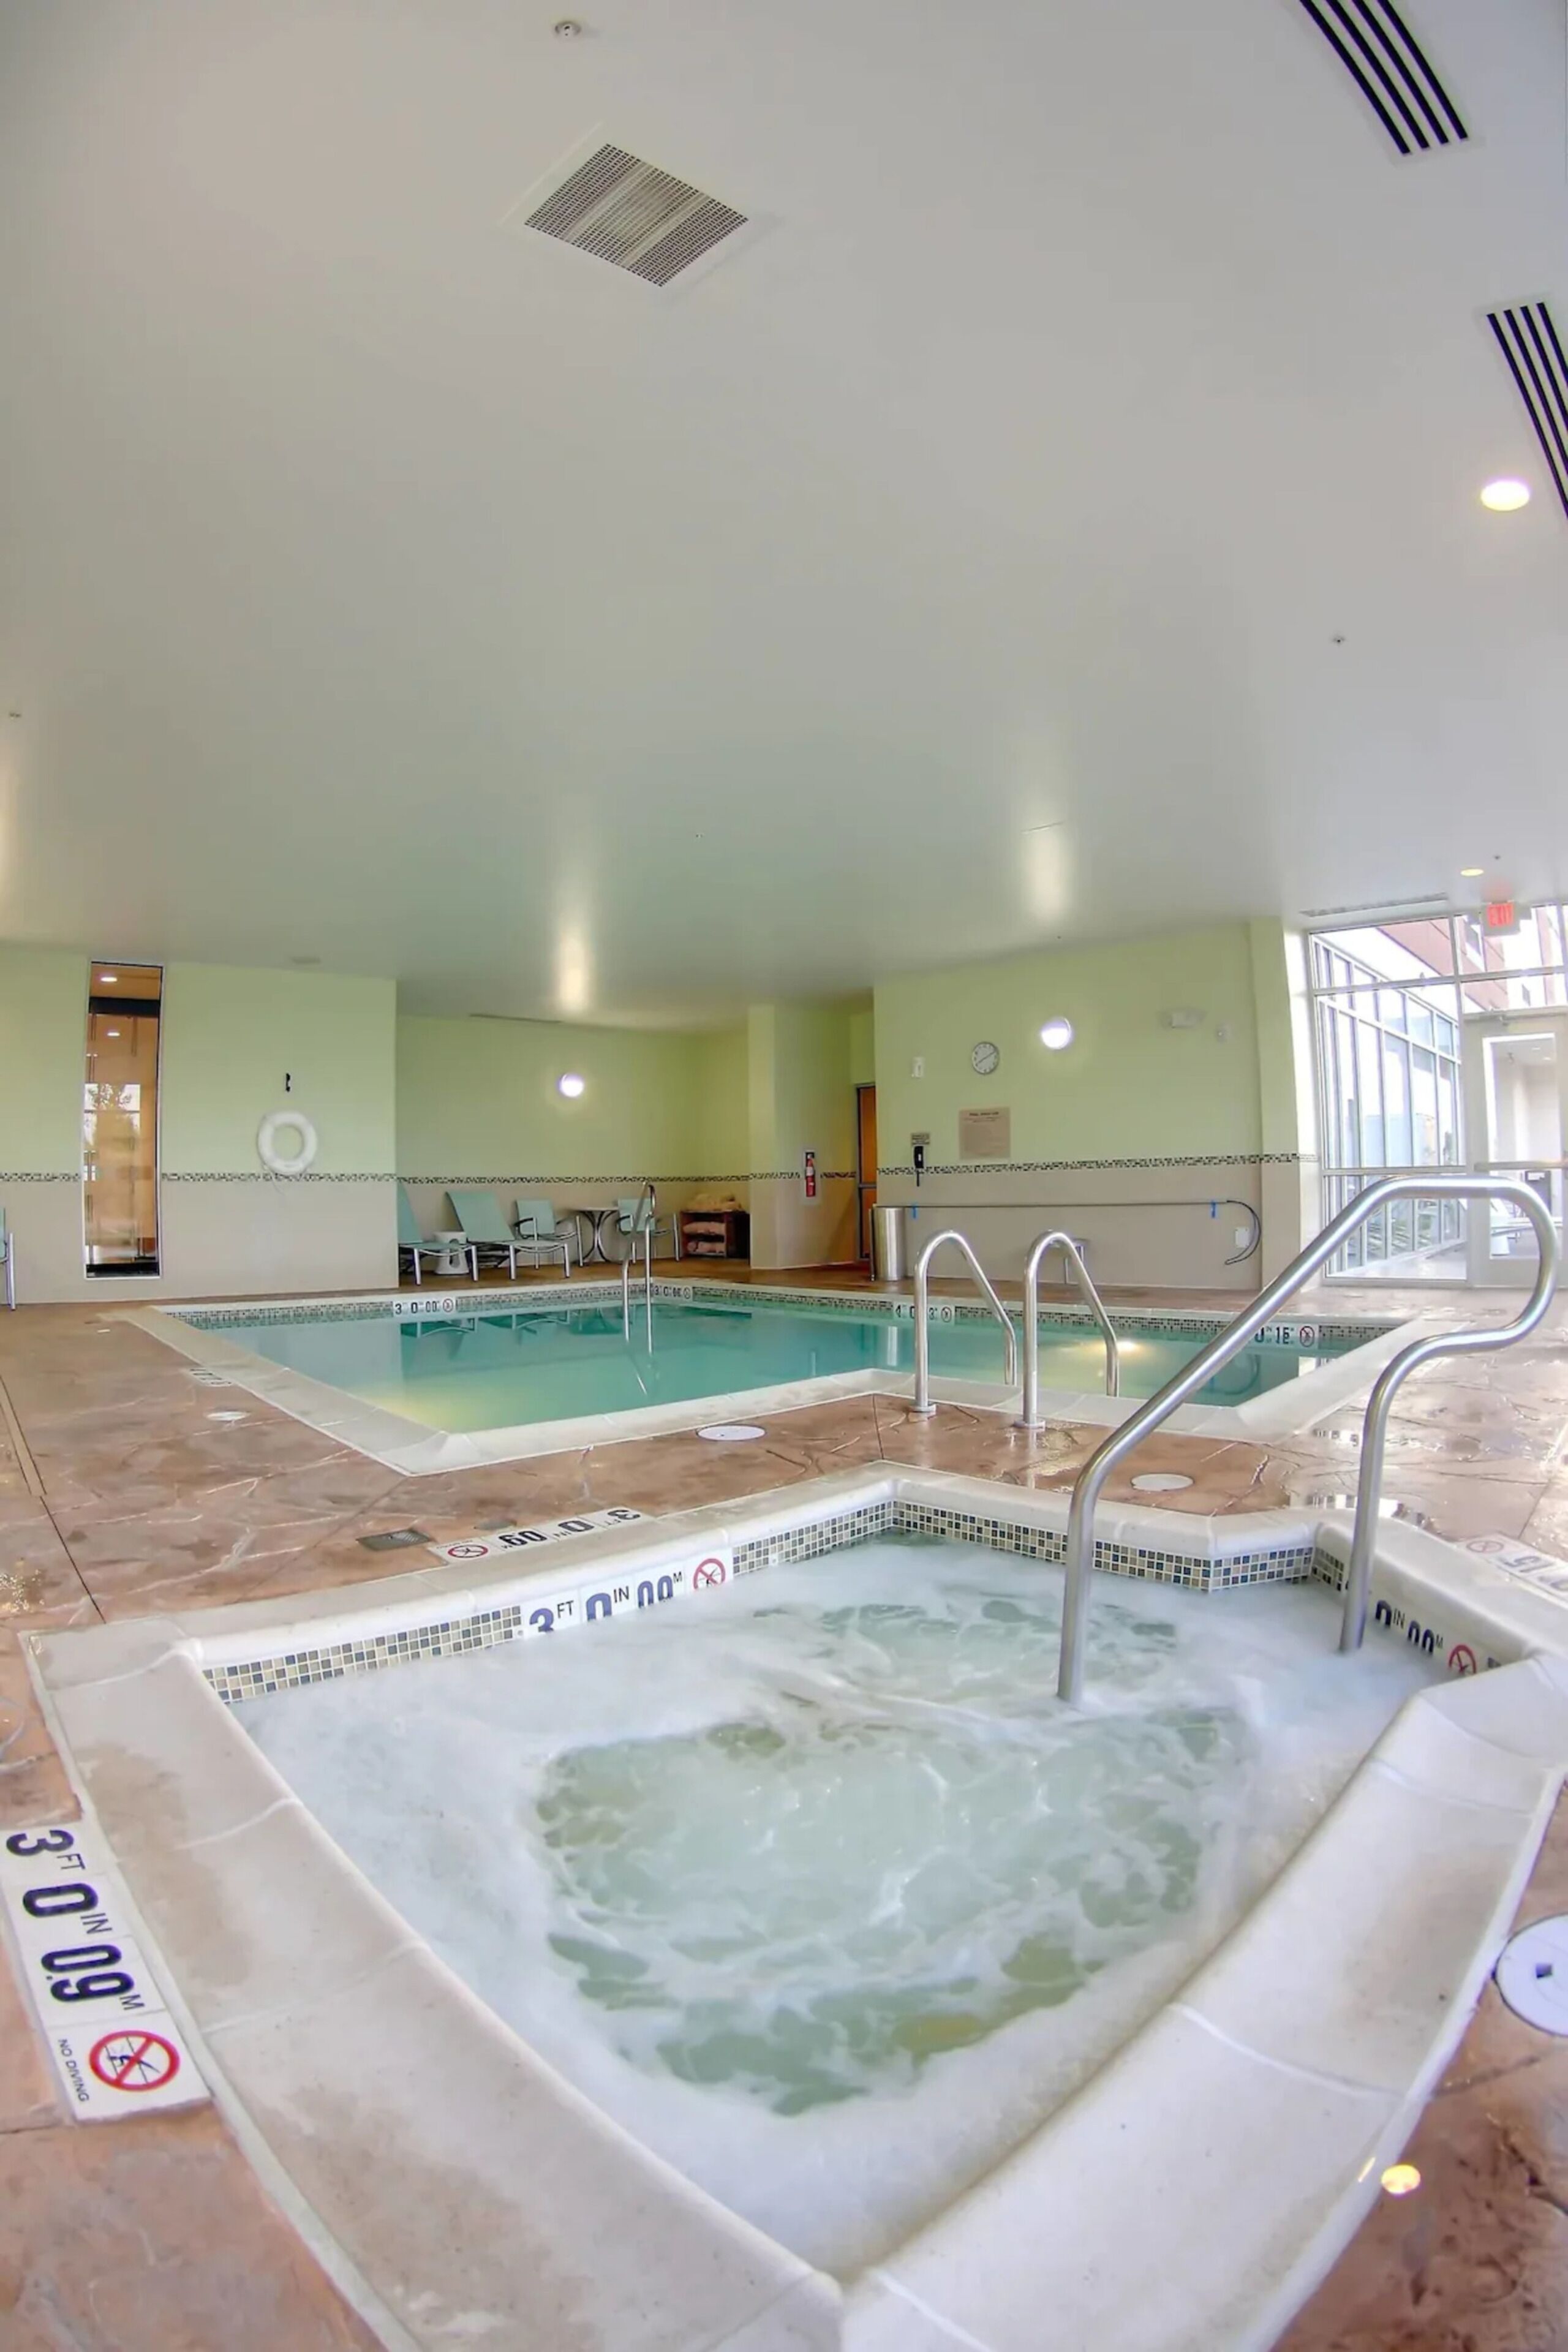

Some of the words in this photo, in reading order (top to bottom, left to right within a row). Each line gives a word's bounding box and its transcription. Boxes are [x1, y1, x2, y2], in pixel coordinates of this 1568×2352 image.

[557, 1600, 574, 1619] FT
[613, 1585, 630, 1604] IN
[6, 1830, 75, 1856] 3
[56, 1852, 86, 1871] FT
[23, 1882, 99, 1918] 0
[80, 1912, 113, 1935] IN
[119, 1994, 146, 2011] M
[58, 2038, 73, 2057] NO
[66, 2060, 89, 2102] DIVING
